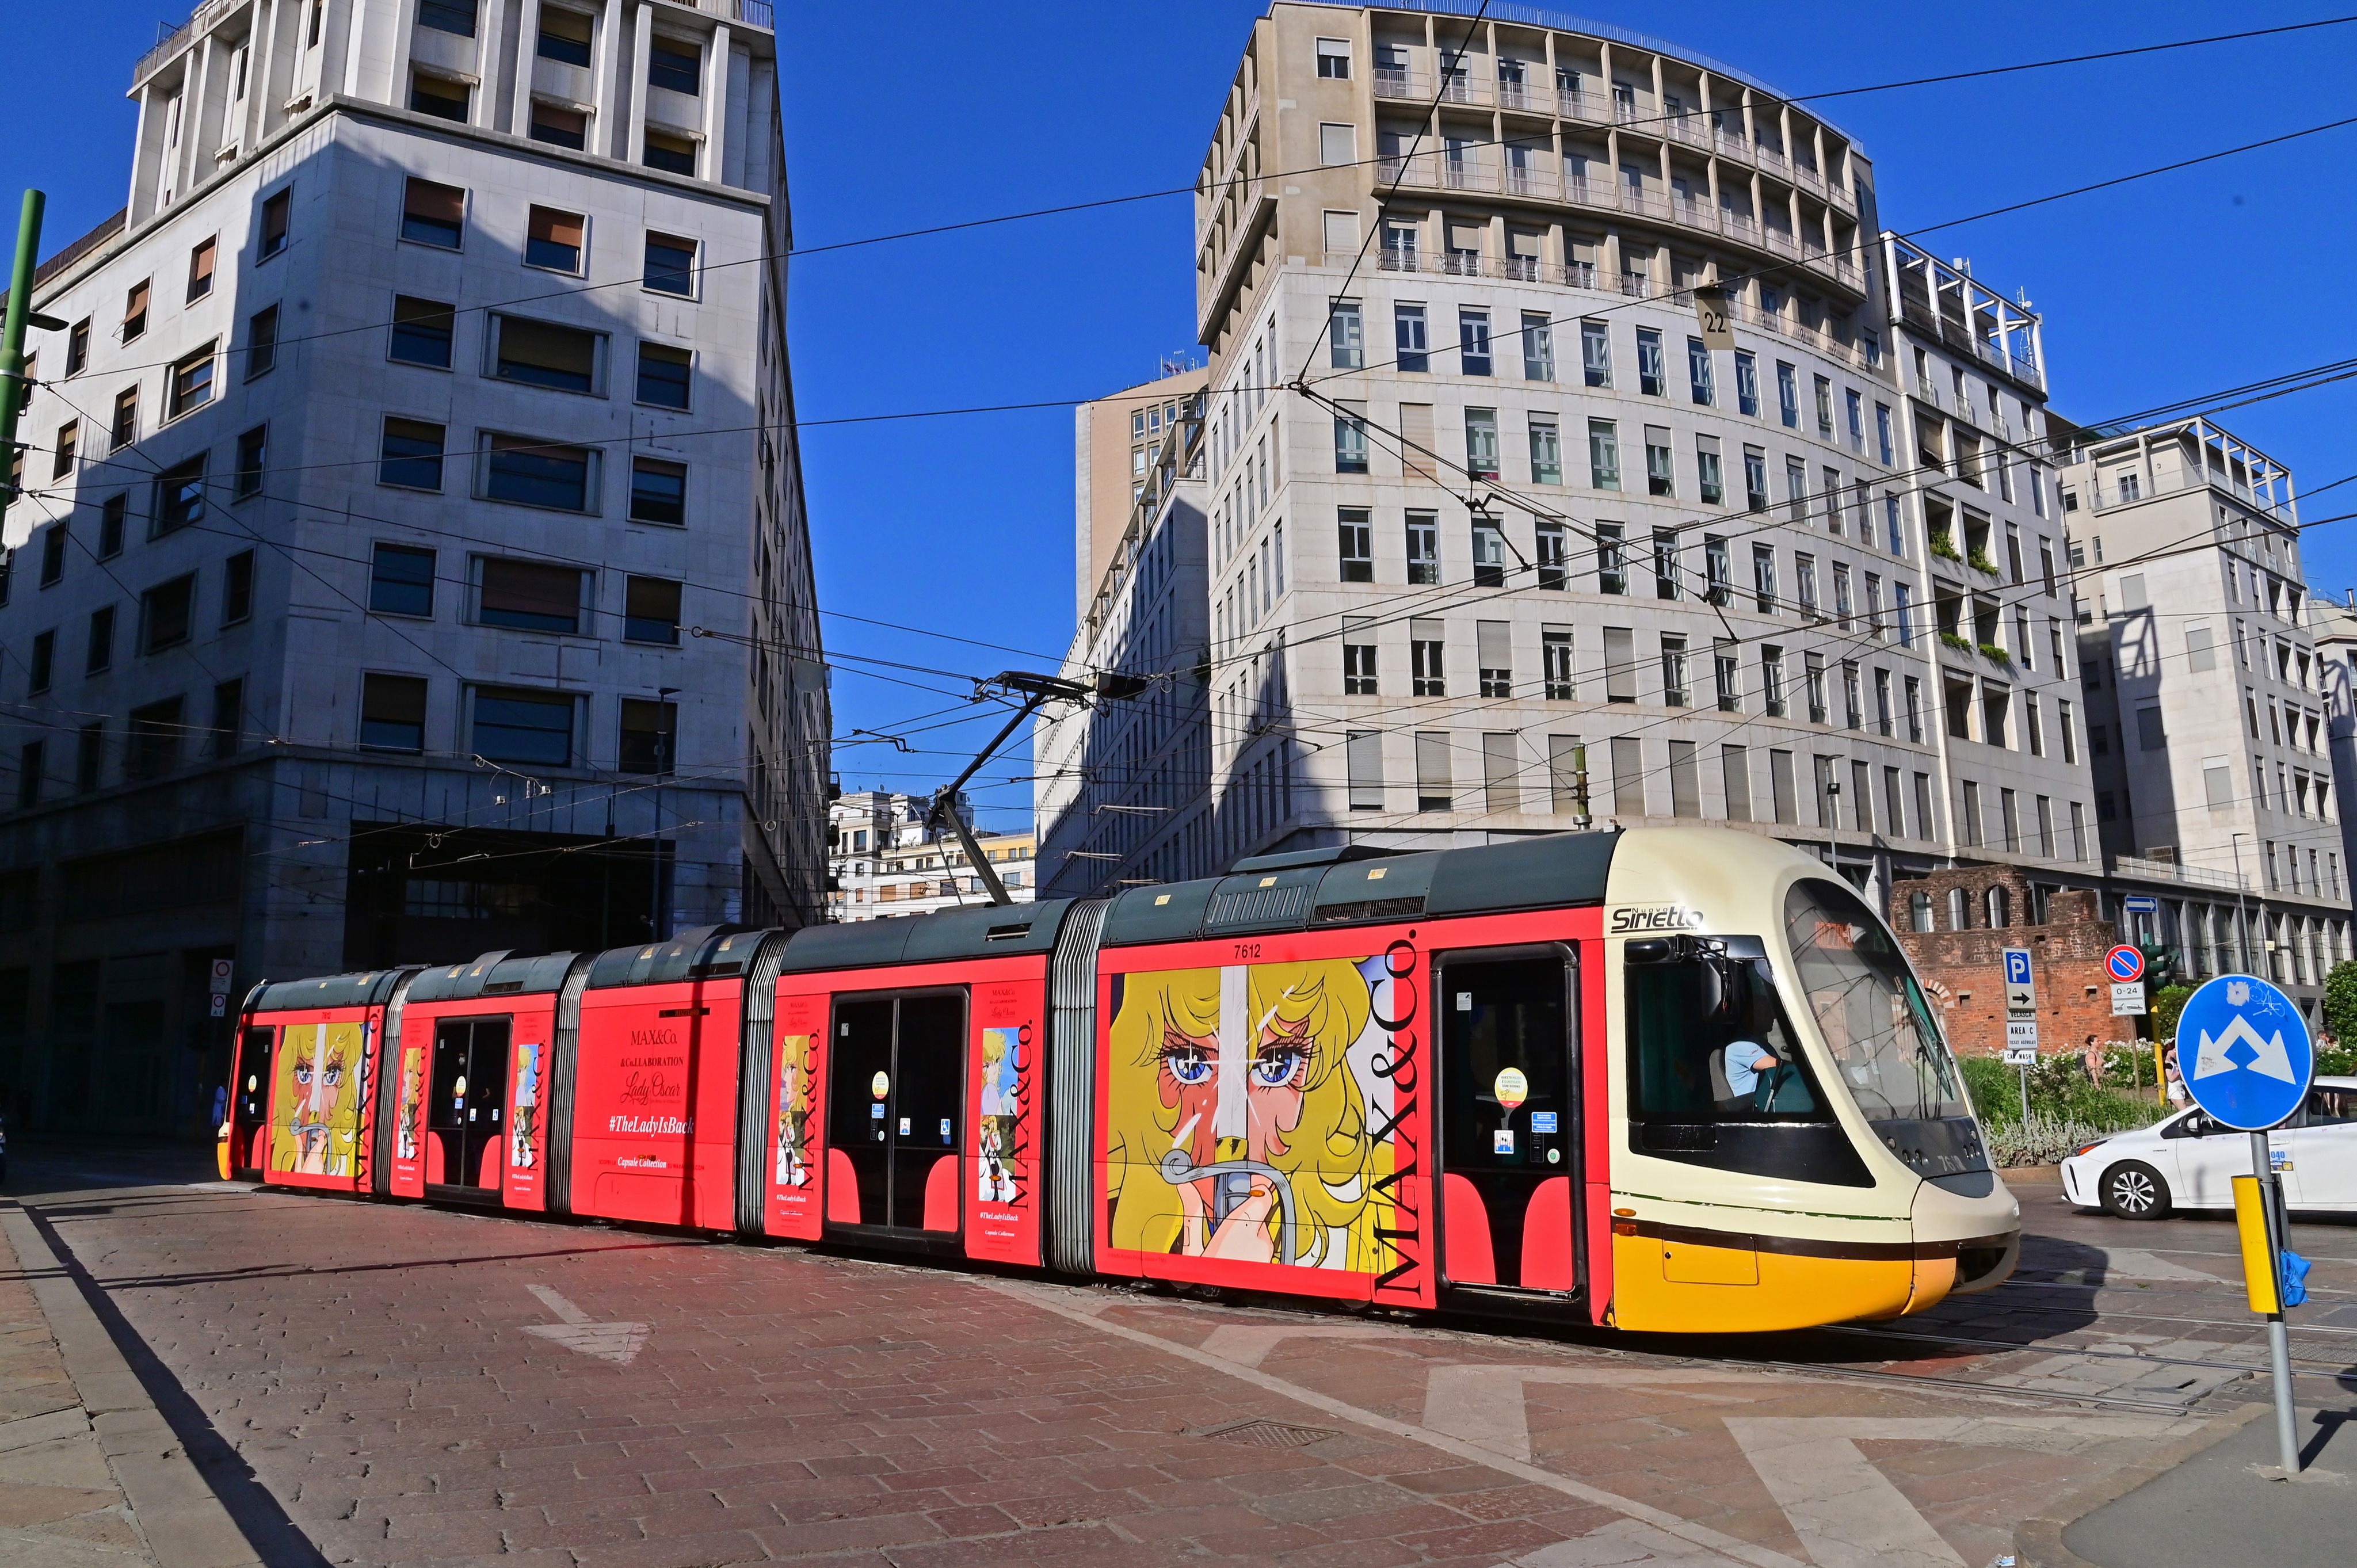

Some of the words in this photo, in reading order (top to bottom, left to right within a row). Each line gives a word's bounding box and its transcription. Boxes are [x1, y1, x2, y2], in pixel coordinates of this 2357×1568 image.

[1704, 311, 1726, 333] 22
[1611, 906, 1703, 930] Sirietto
[1234, 943, 1261, 959] 7612
[2011, 959, 2025, 982] P
[631, 1029, 677, 1046] MAX&Co.
[2011, 1027, 2026, 1035] AREA
[2030, 1027, 2034, 1035] C
[353, 1009, 380, 1189] MAX&Co.
[620, 1071, 650, 1105] Lady
[652, 1071, 680, 1097] Oscar
[410, 1043, 428, 1163] MAX&Co.
[527, 1039, 546, 1173] MAX&Co.
[798, 1028, 820, 1195] MAX&Co.
[1370, 929, 1422, 1300] MAX&Co.
[609, 1115, 695, 1138] #TheLadyIsBack
[1008, 1019, 1032, 1212] MAX&Co.
[617, 1157, 638, 1169] Capsule
[639, 1158, 666, 1169] Collection
[979, 1212, 1019, 1222] #TheLadyIsBack
